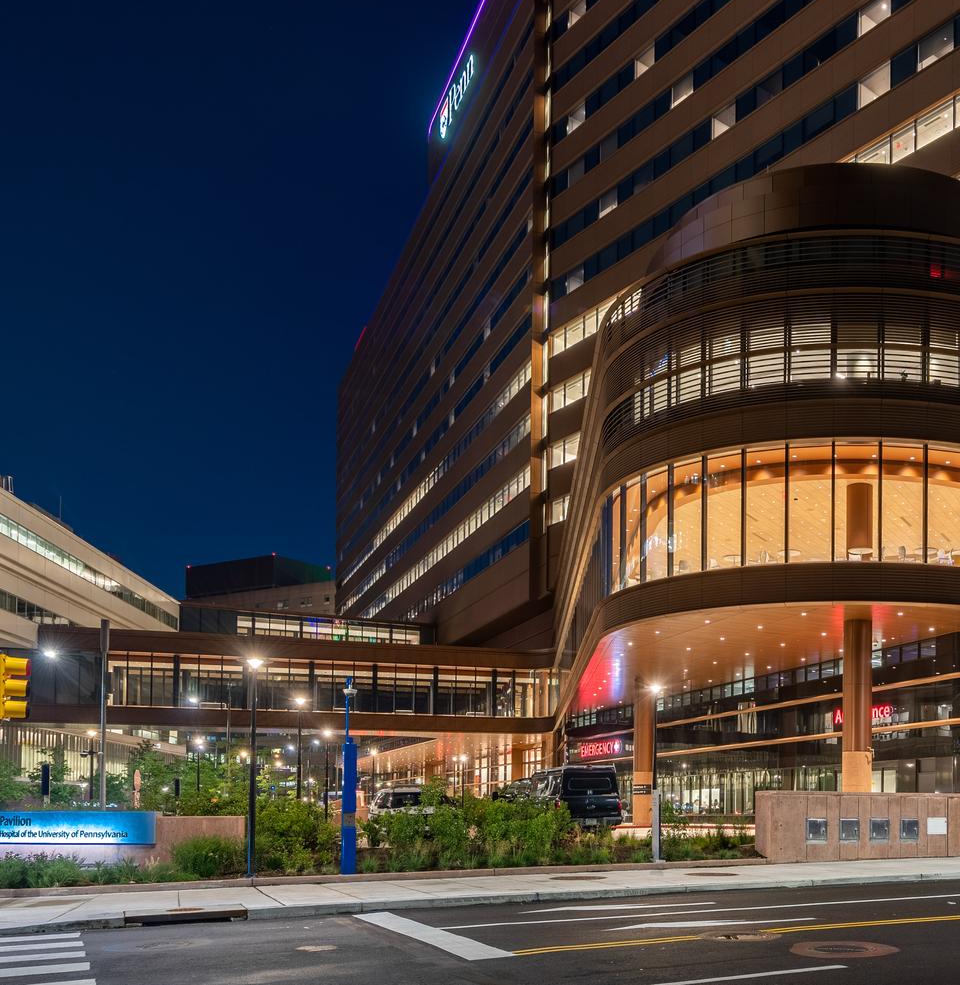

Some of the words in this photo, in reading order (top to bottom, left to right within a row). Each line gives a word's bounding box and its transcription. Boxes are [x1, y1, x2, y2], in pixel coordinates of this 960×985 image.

[448, 54, 474, 126] Penn
[581, 742, 614, 757] EMERGENCY
[0, 815, 32, 826] Pavilion
[0, 830, 20, 839] Hospital
[20, 829, 27, 837] of
[38, 830, 70, 840] University
[71, 829, 79, 837] of
[80, 830, 128, 840] Pennsylvania
